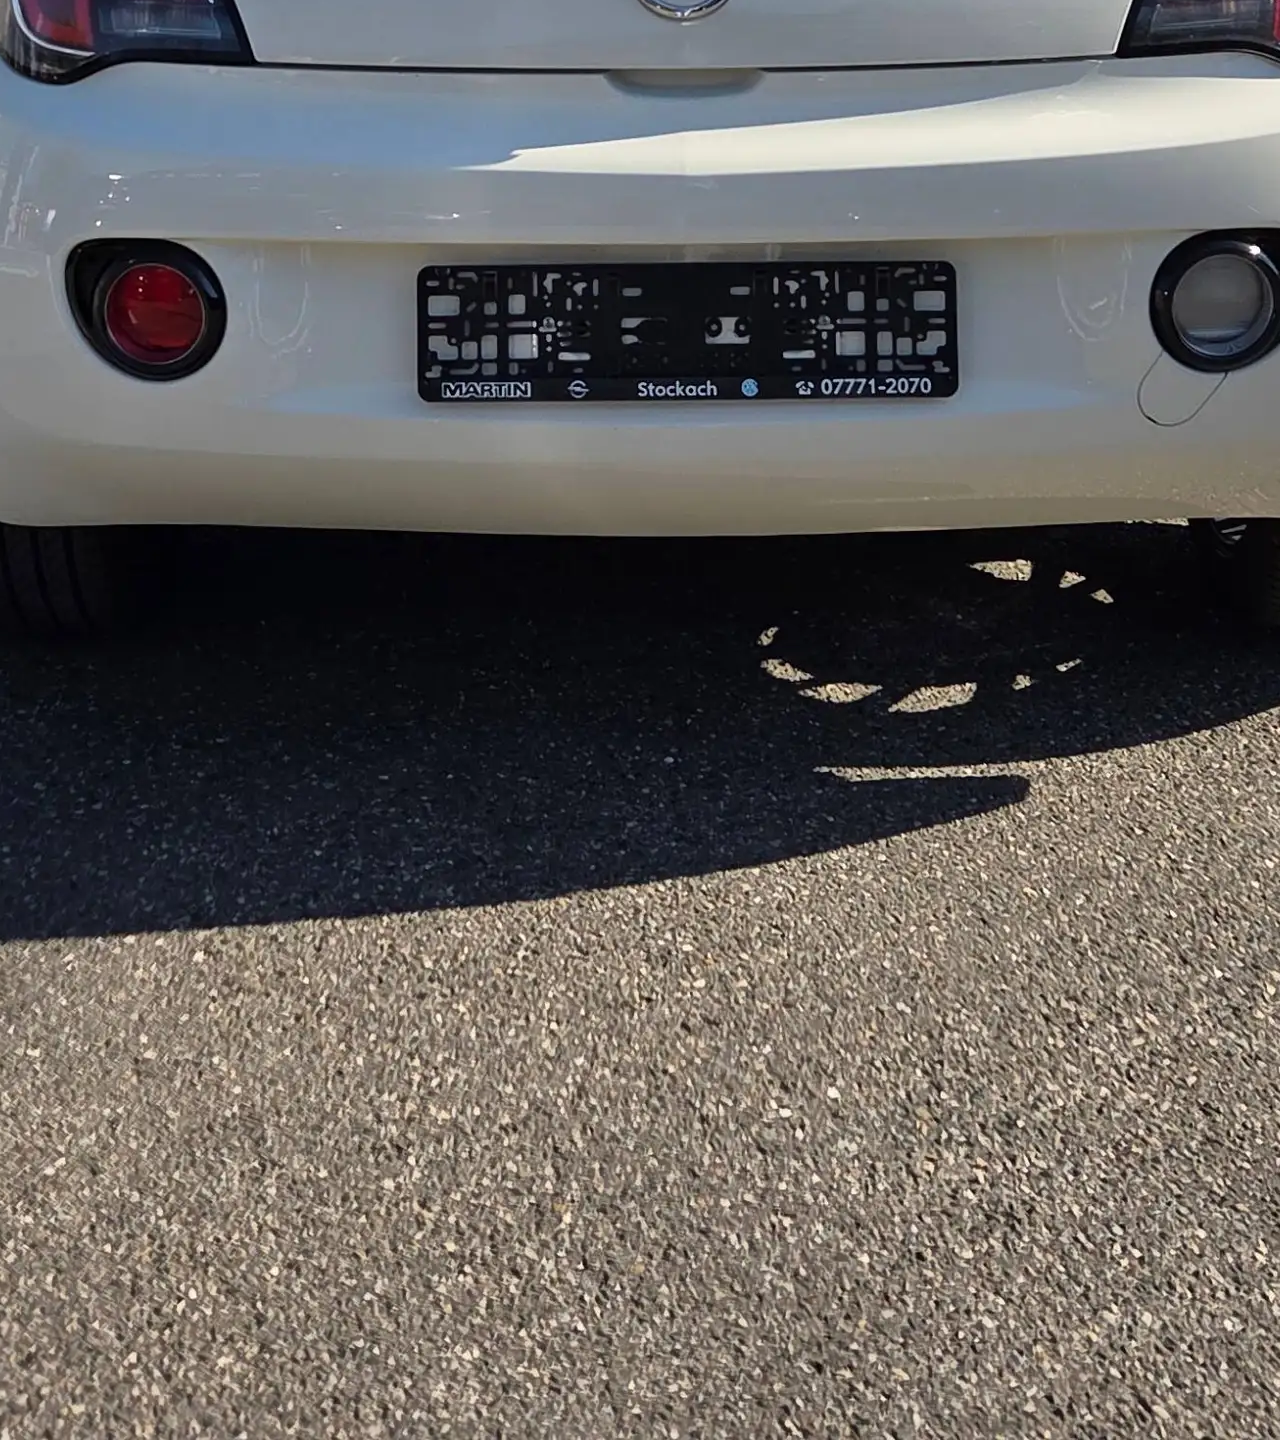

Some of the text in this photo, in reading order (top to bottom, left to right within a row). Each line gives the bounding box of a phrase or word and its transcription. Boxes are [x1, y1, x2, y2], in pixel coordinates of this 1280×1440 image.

[441, 378, 932, 398] MARTIN Stockach 07771-2070
